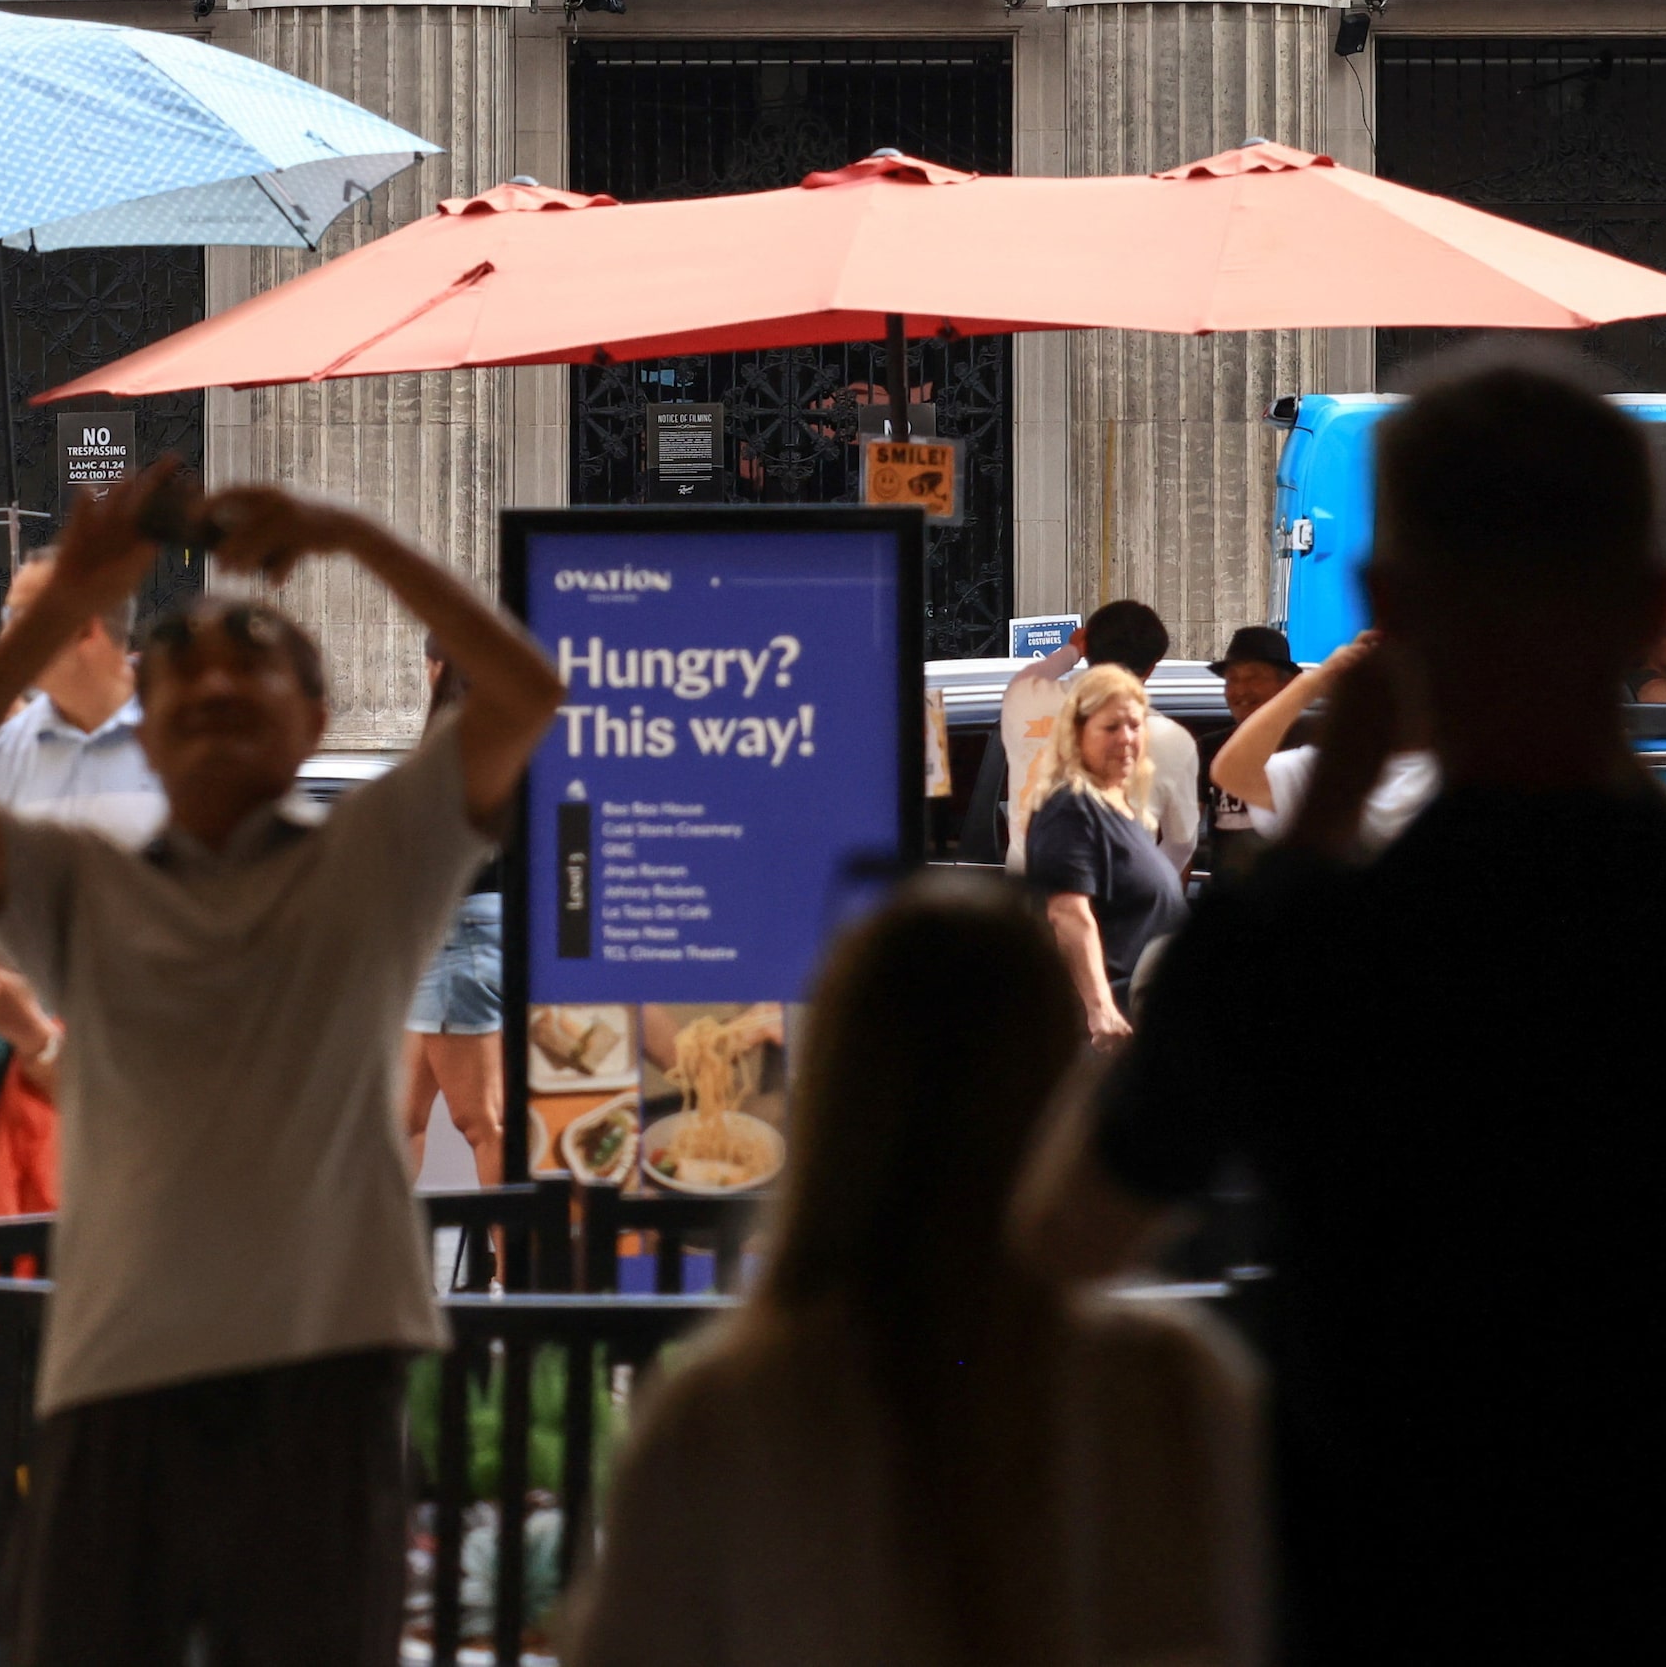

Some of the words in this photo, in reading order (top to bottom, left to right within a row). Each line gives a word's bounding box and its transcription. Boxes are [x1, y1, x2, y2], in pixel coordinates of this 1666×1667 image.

[658, 414, 678, 423] NOTICE
[680, 414, 688, 423] OF
[689, 413, 713, 423] FILMING
[82, 427, 111, 446] NO
[67, 445, 127, 456] TRESPASSING
[69, 461, 98, 470] LAMC
[99, 460, 125, 470] 41.24
[69, 471, 88, 480] 602
[89, 470, 106, 480] (10)
[557, 635, 801, 699] Hungry?
[555, 704, 676, 758] This
[688, 703, 816, 768] way!
